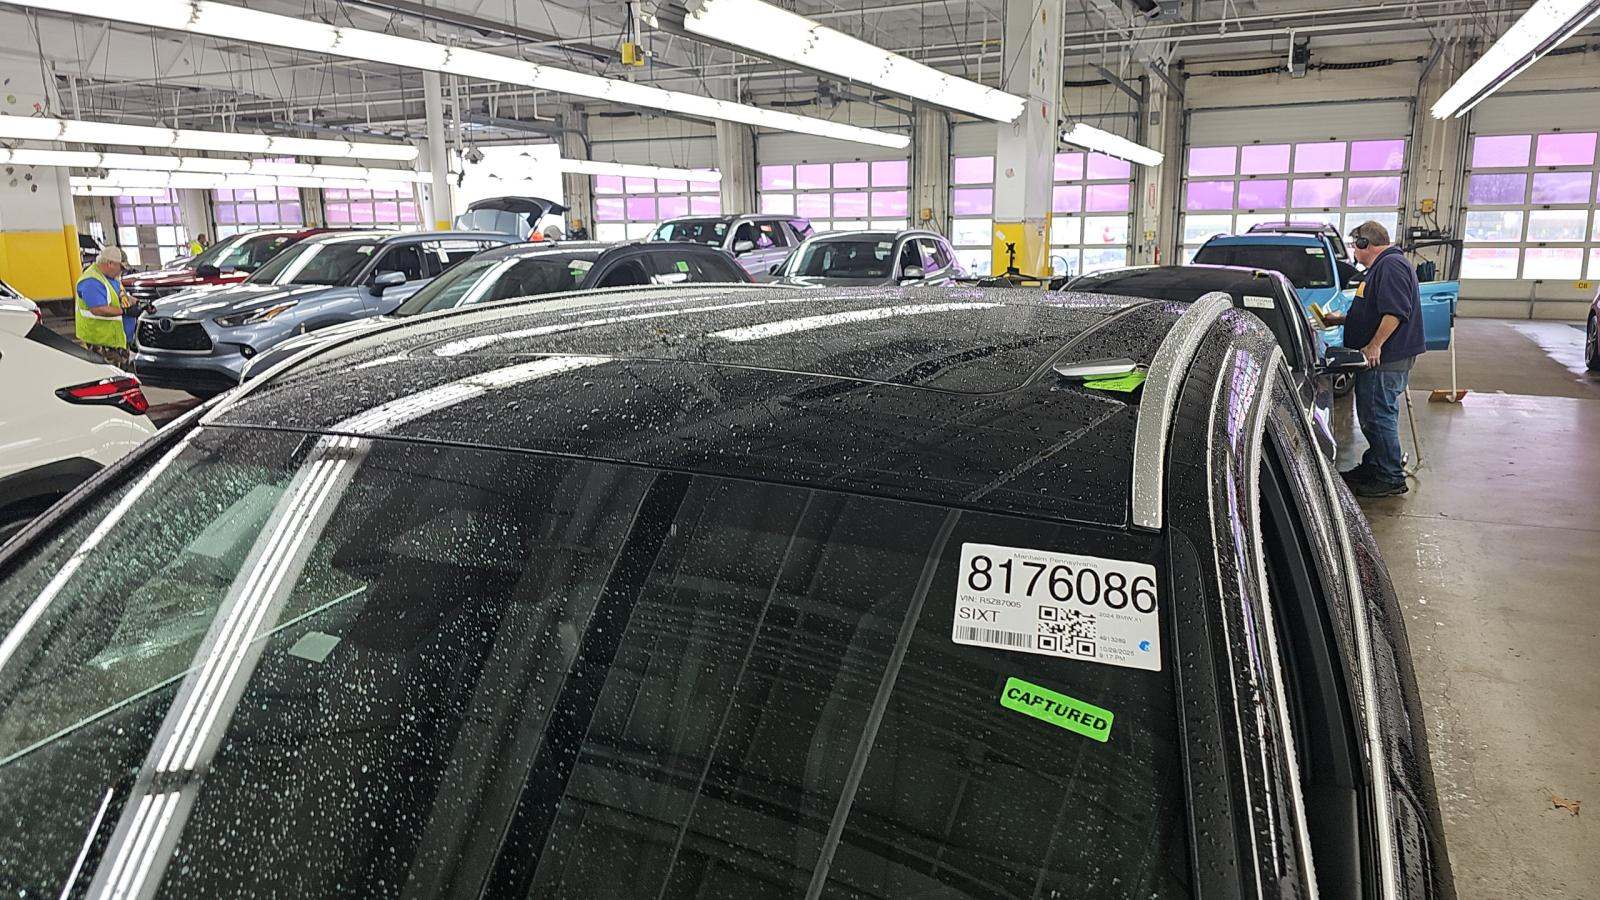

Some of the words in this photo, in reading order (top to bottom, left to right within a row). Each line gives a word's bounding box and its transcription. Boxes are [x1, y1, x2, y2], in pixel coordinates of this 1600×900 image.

[1013, 553, 1048, 562] Manheim
[1049, 557, 1098, 568] Pennsylvania
[968, 555, 1157, 614] 8176086
[959, 606, 1001, 623] SIXT
